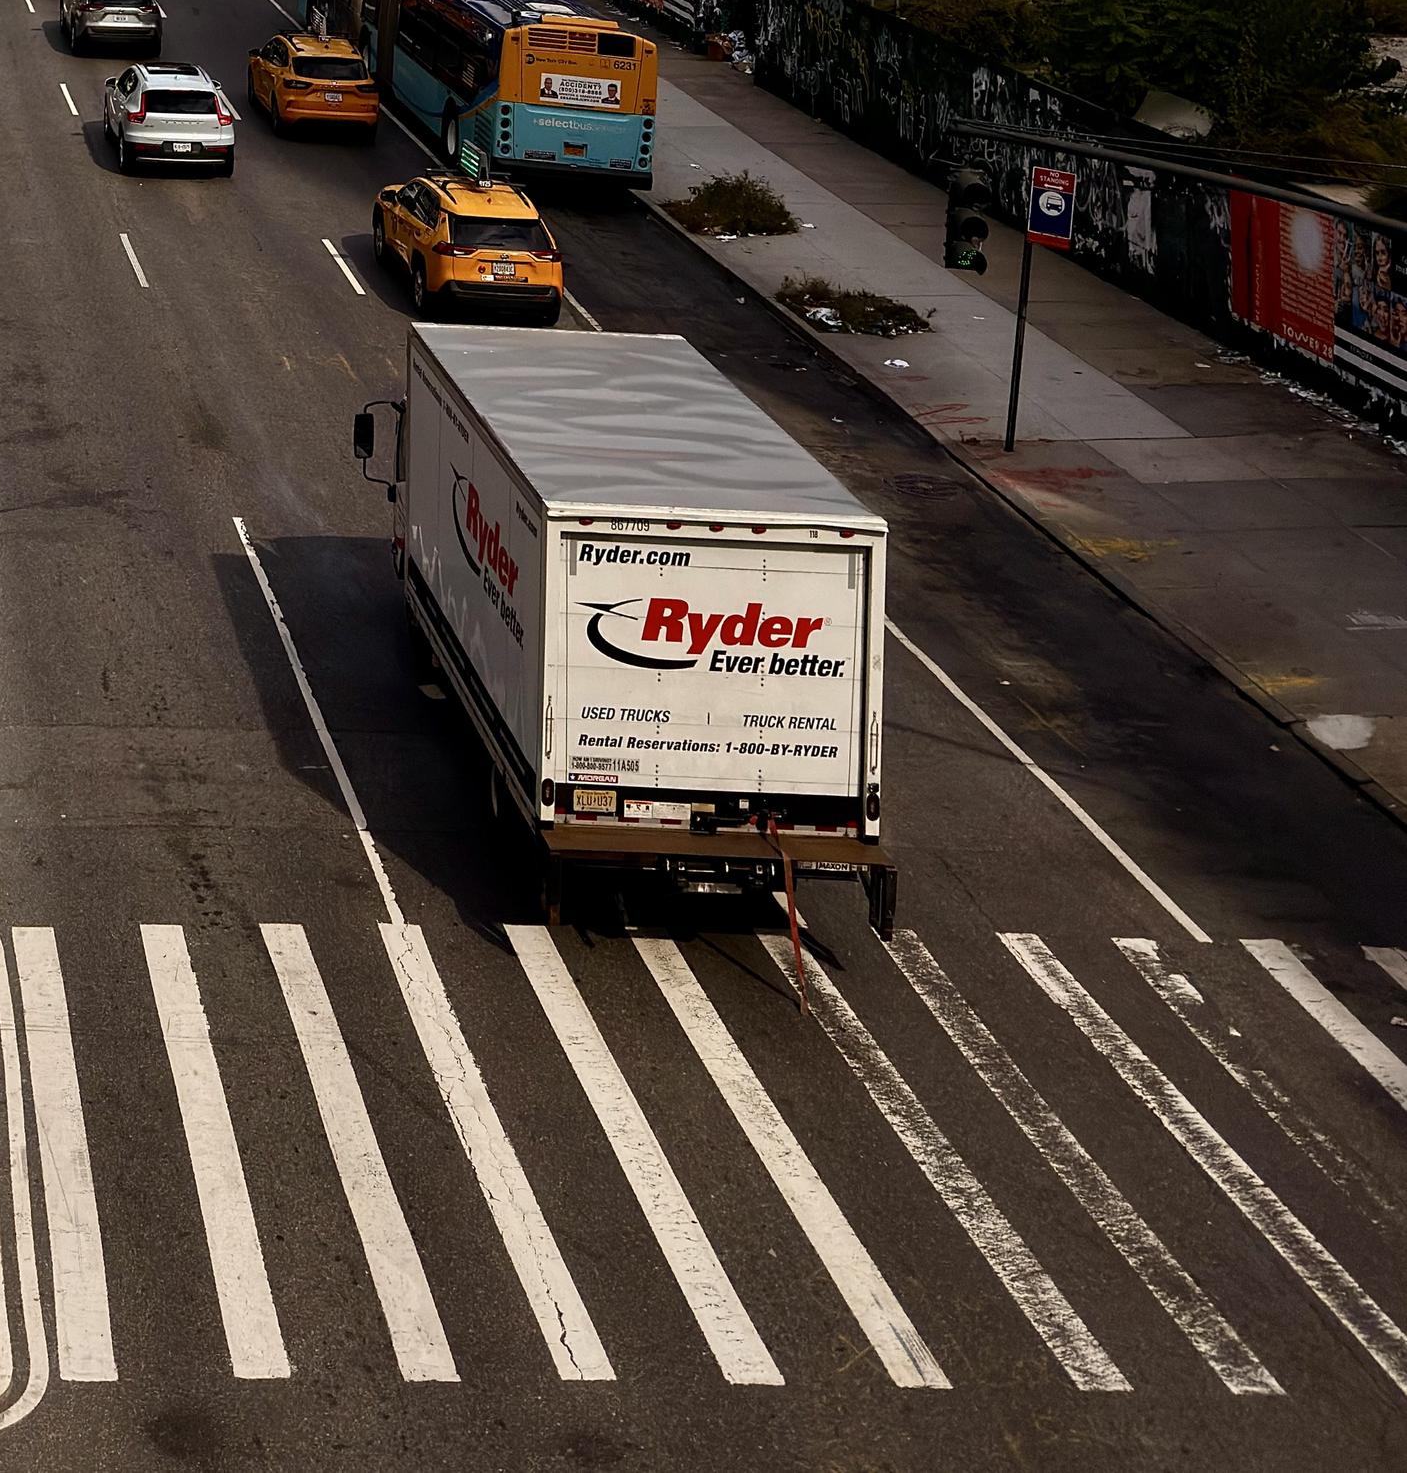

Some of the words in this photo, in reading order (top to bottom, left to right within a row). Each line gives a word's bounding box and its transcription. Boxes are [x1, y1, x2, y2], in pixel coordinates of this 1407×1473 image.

[613, 60, 637, 71] 6231
[1039, 175, 1070, 186] STANDING
[1282, 324, 1320, 350] TOWER
[610, 518, 651, 532] 867709
[465, 483, 519, 598] Ryder
[579, 543, 691, 567] Ryder.com
[483, 565, 501, 610] Ever
[500, 598, 524, 650] better.
[641, 598, 824, 655] Ryder
[709, 650, 765, 673] Ever
[768, 653, 845, 678] better.
[581, 706, 616, 720] USED
[619, 708, 671, 723] TRUCKS
[742, 714, 786, 729] TRUCK
[787, 716, 838, 731] RENTAL
[578, 733, 623, 749] Rental
[627, 736, 721, 754] Reservations:
[725, 741, 839, 759] 1-800-BY-RYDER
[612, 758, 639, 772] 11A505
[577, 774, 618, 784] MORGAN
[819, 862, 849, 871] MAXON
